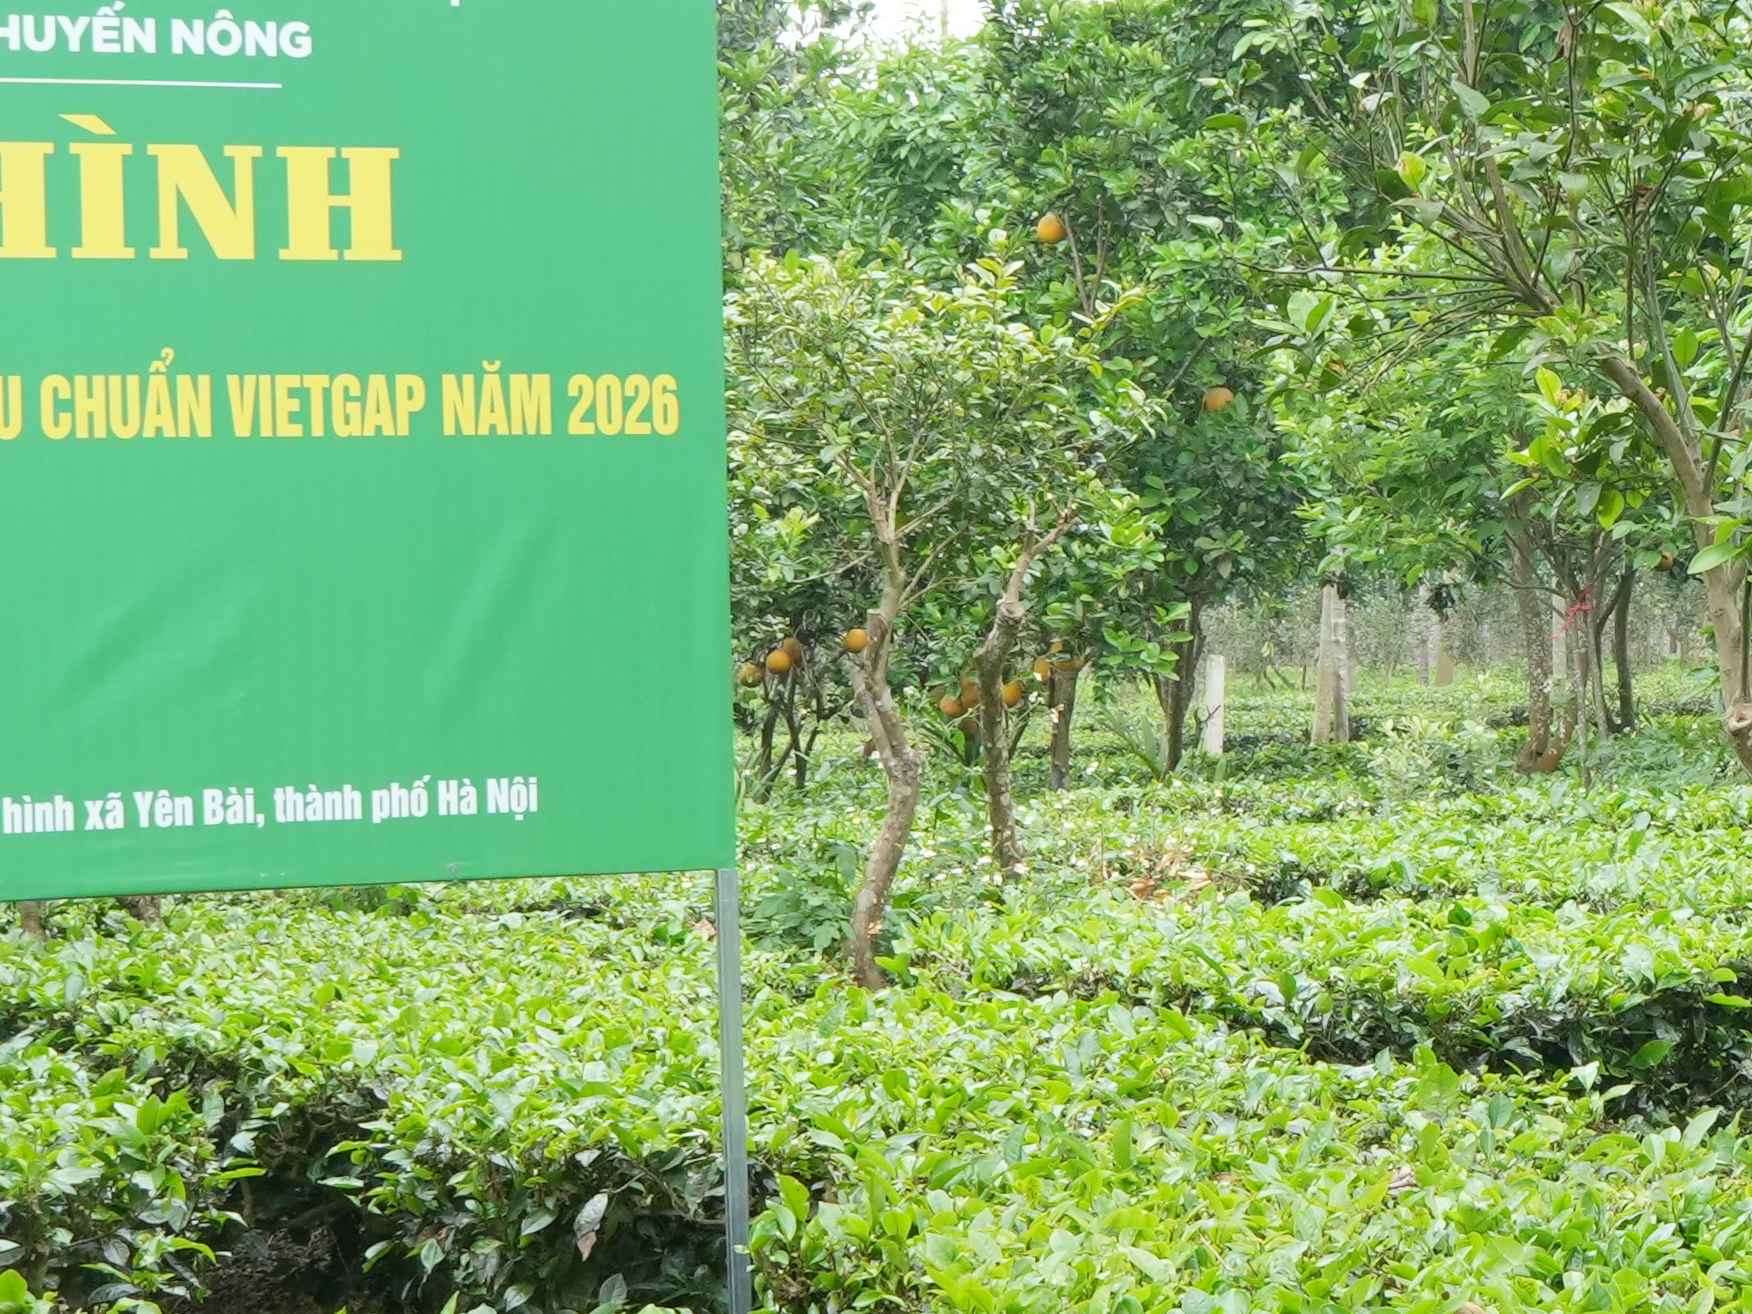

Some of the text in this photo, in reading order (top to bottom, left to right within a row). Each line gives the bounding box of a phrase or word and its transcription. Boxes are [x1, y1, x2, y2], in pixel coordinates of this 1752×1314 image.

[172, 9, 312, 58] NÔNG
[40, 348, 212, 439] CHUẨN
[227, 373, 425, 437] VIETGAP
[442, 361, 552, 435] NĂM
[568, 374, 679, 435] 2026
[3, 795, 74, 833] hình
[85, 792, 124, 830] xã
[134, 790, 193, 827] Yên
[204, 787, 264, 827] Bài,
[274, 784, 362, 822] thành
[372, 775, 430, 823] phố
[438, 779, 477, 815] Hà
[487, 777, 537, 820] Nội
